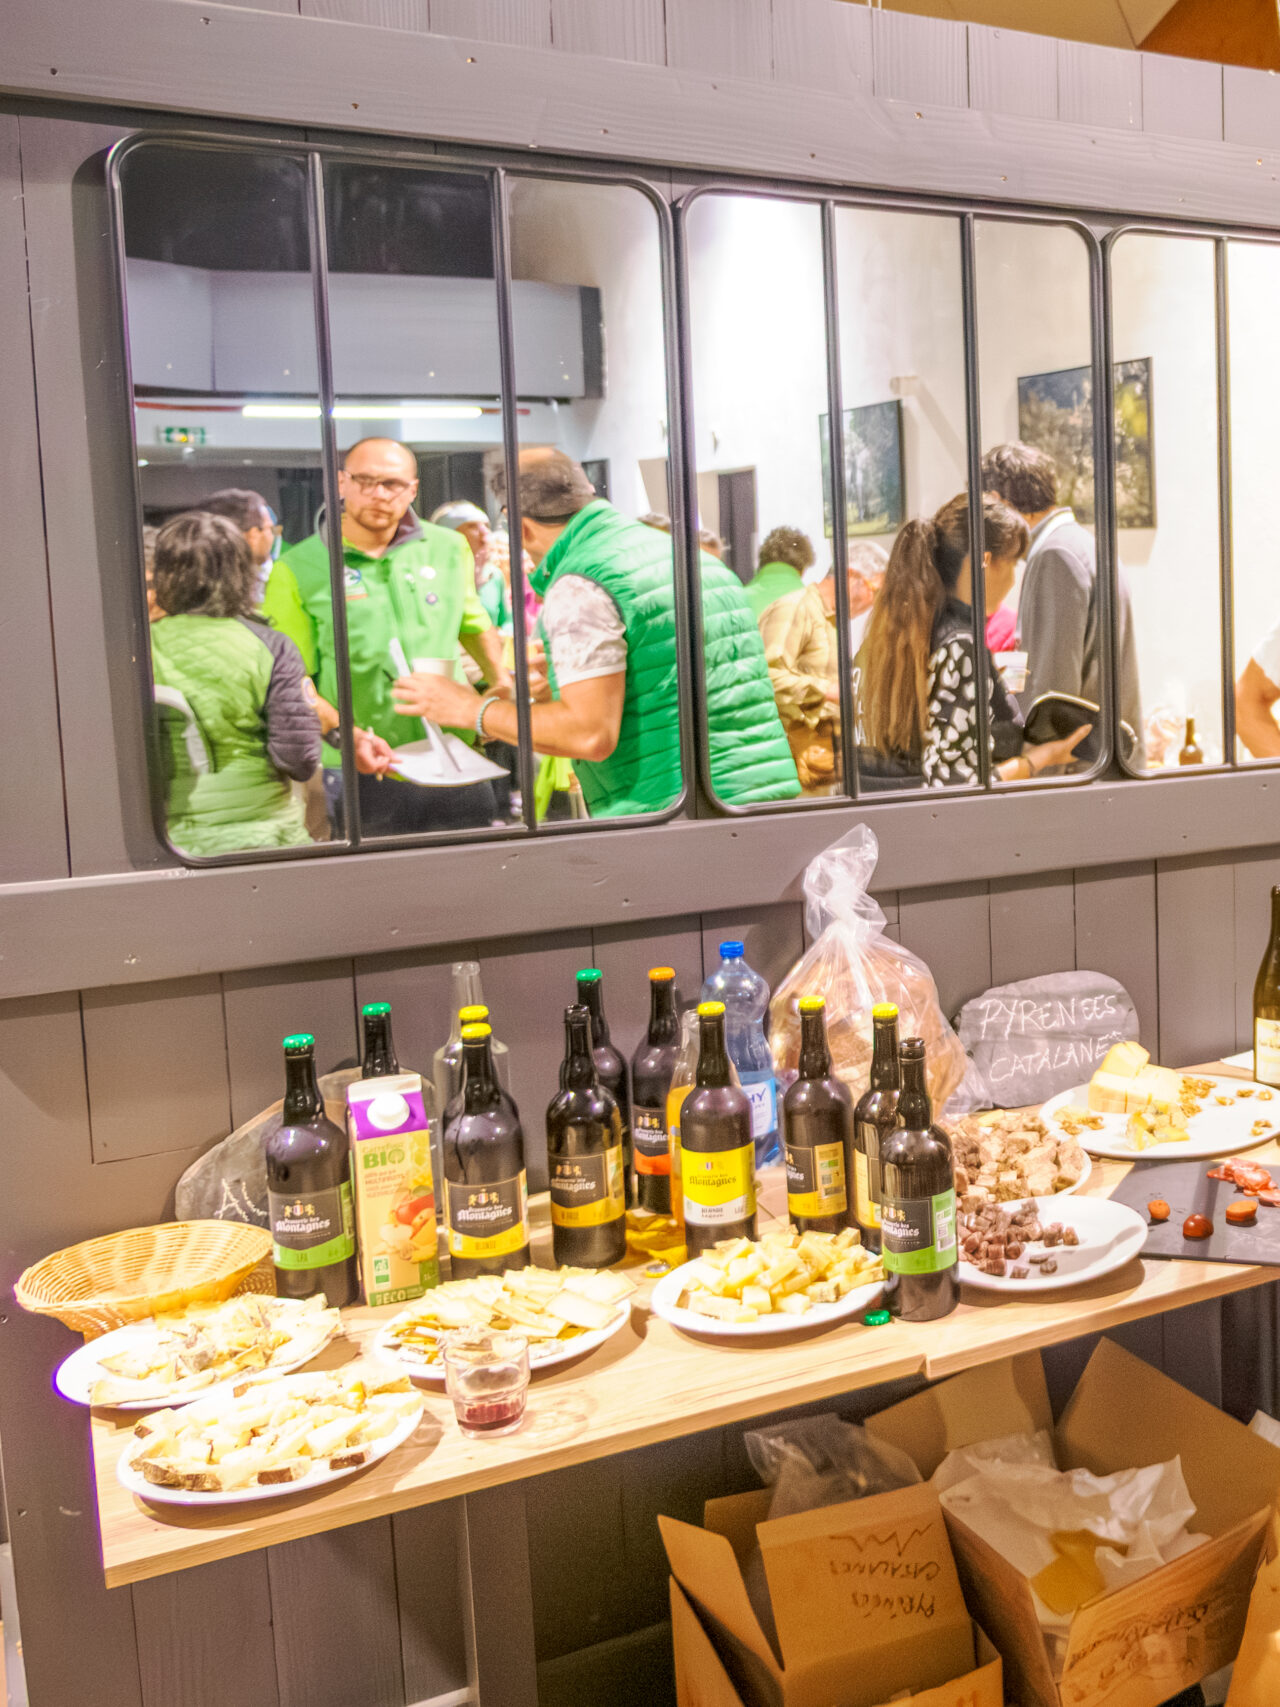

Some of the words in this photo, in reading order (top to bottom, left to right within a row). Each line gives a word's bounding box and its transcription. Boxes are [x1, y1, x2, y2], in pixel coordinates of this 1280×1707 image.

[363, 1149, 405, 1170] BIO
[688, 1175, 737, 1188] Montagnes
[457, 1206, 513, 1222] Montagnes
[276, 1218, 331, 1233] Montagnes
